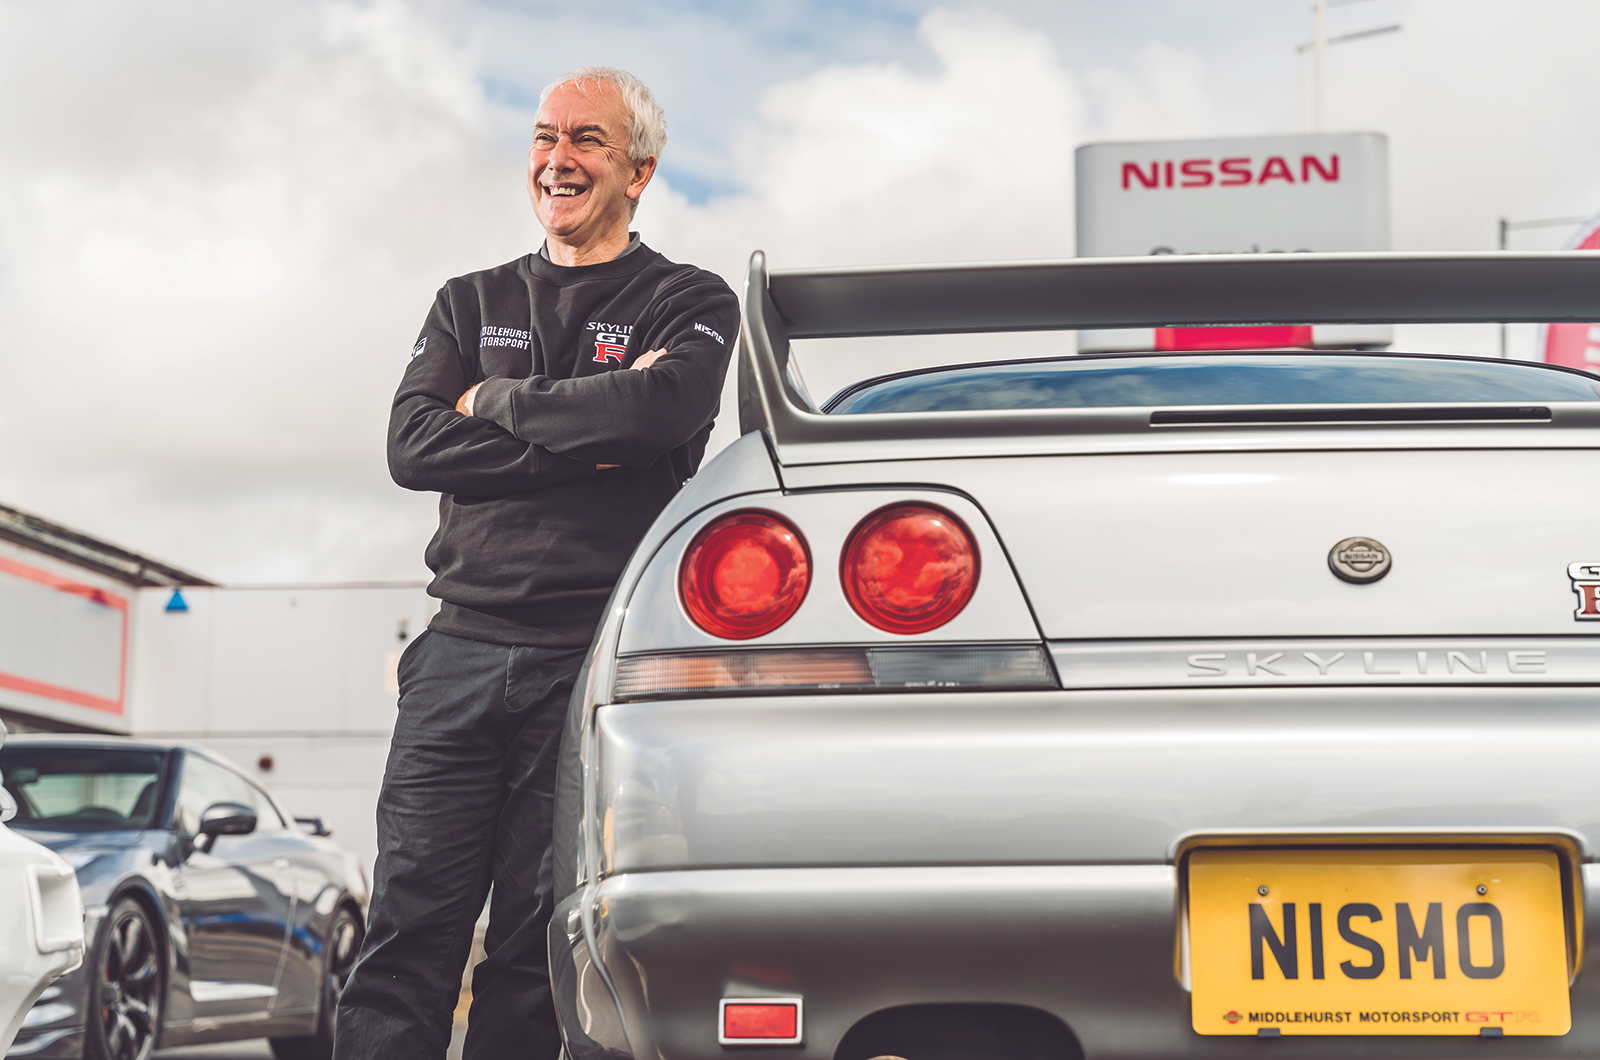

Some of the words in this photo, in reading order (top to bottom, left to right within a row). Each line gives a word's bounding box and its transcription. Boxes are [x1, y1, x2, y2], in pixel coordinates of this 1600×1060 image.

[1121, 154, 1340, 190] NISSAN
[1186, 650, 1547, 677] SKYLINE
[1248, 902, 1505, 980] NISMO
[1248, 1011, 1352, 1023] MIDDLEHURST
[1359, 1011, 1460, 1023] MOTORSPORT
